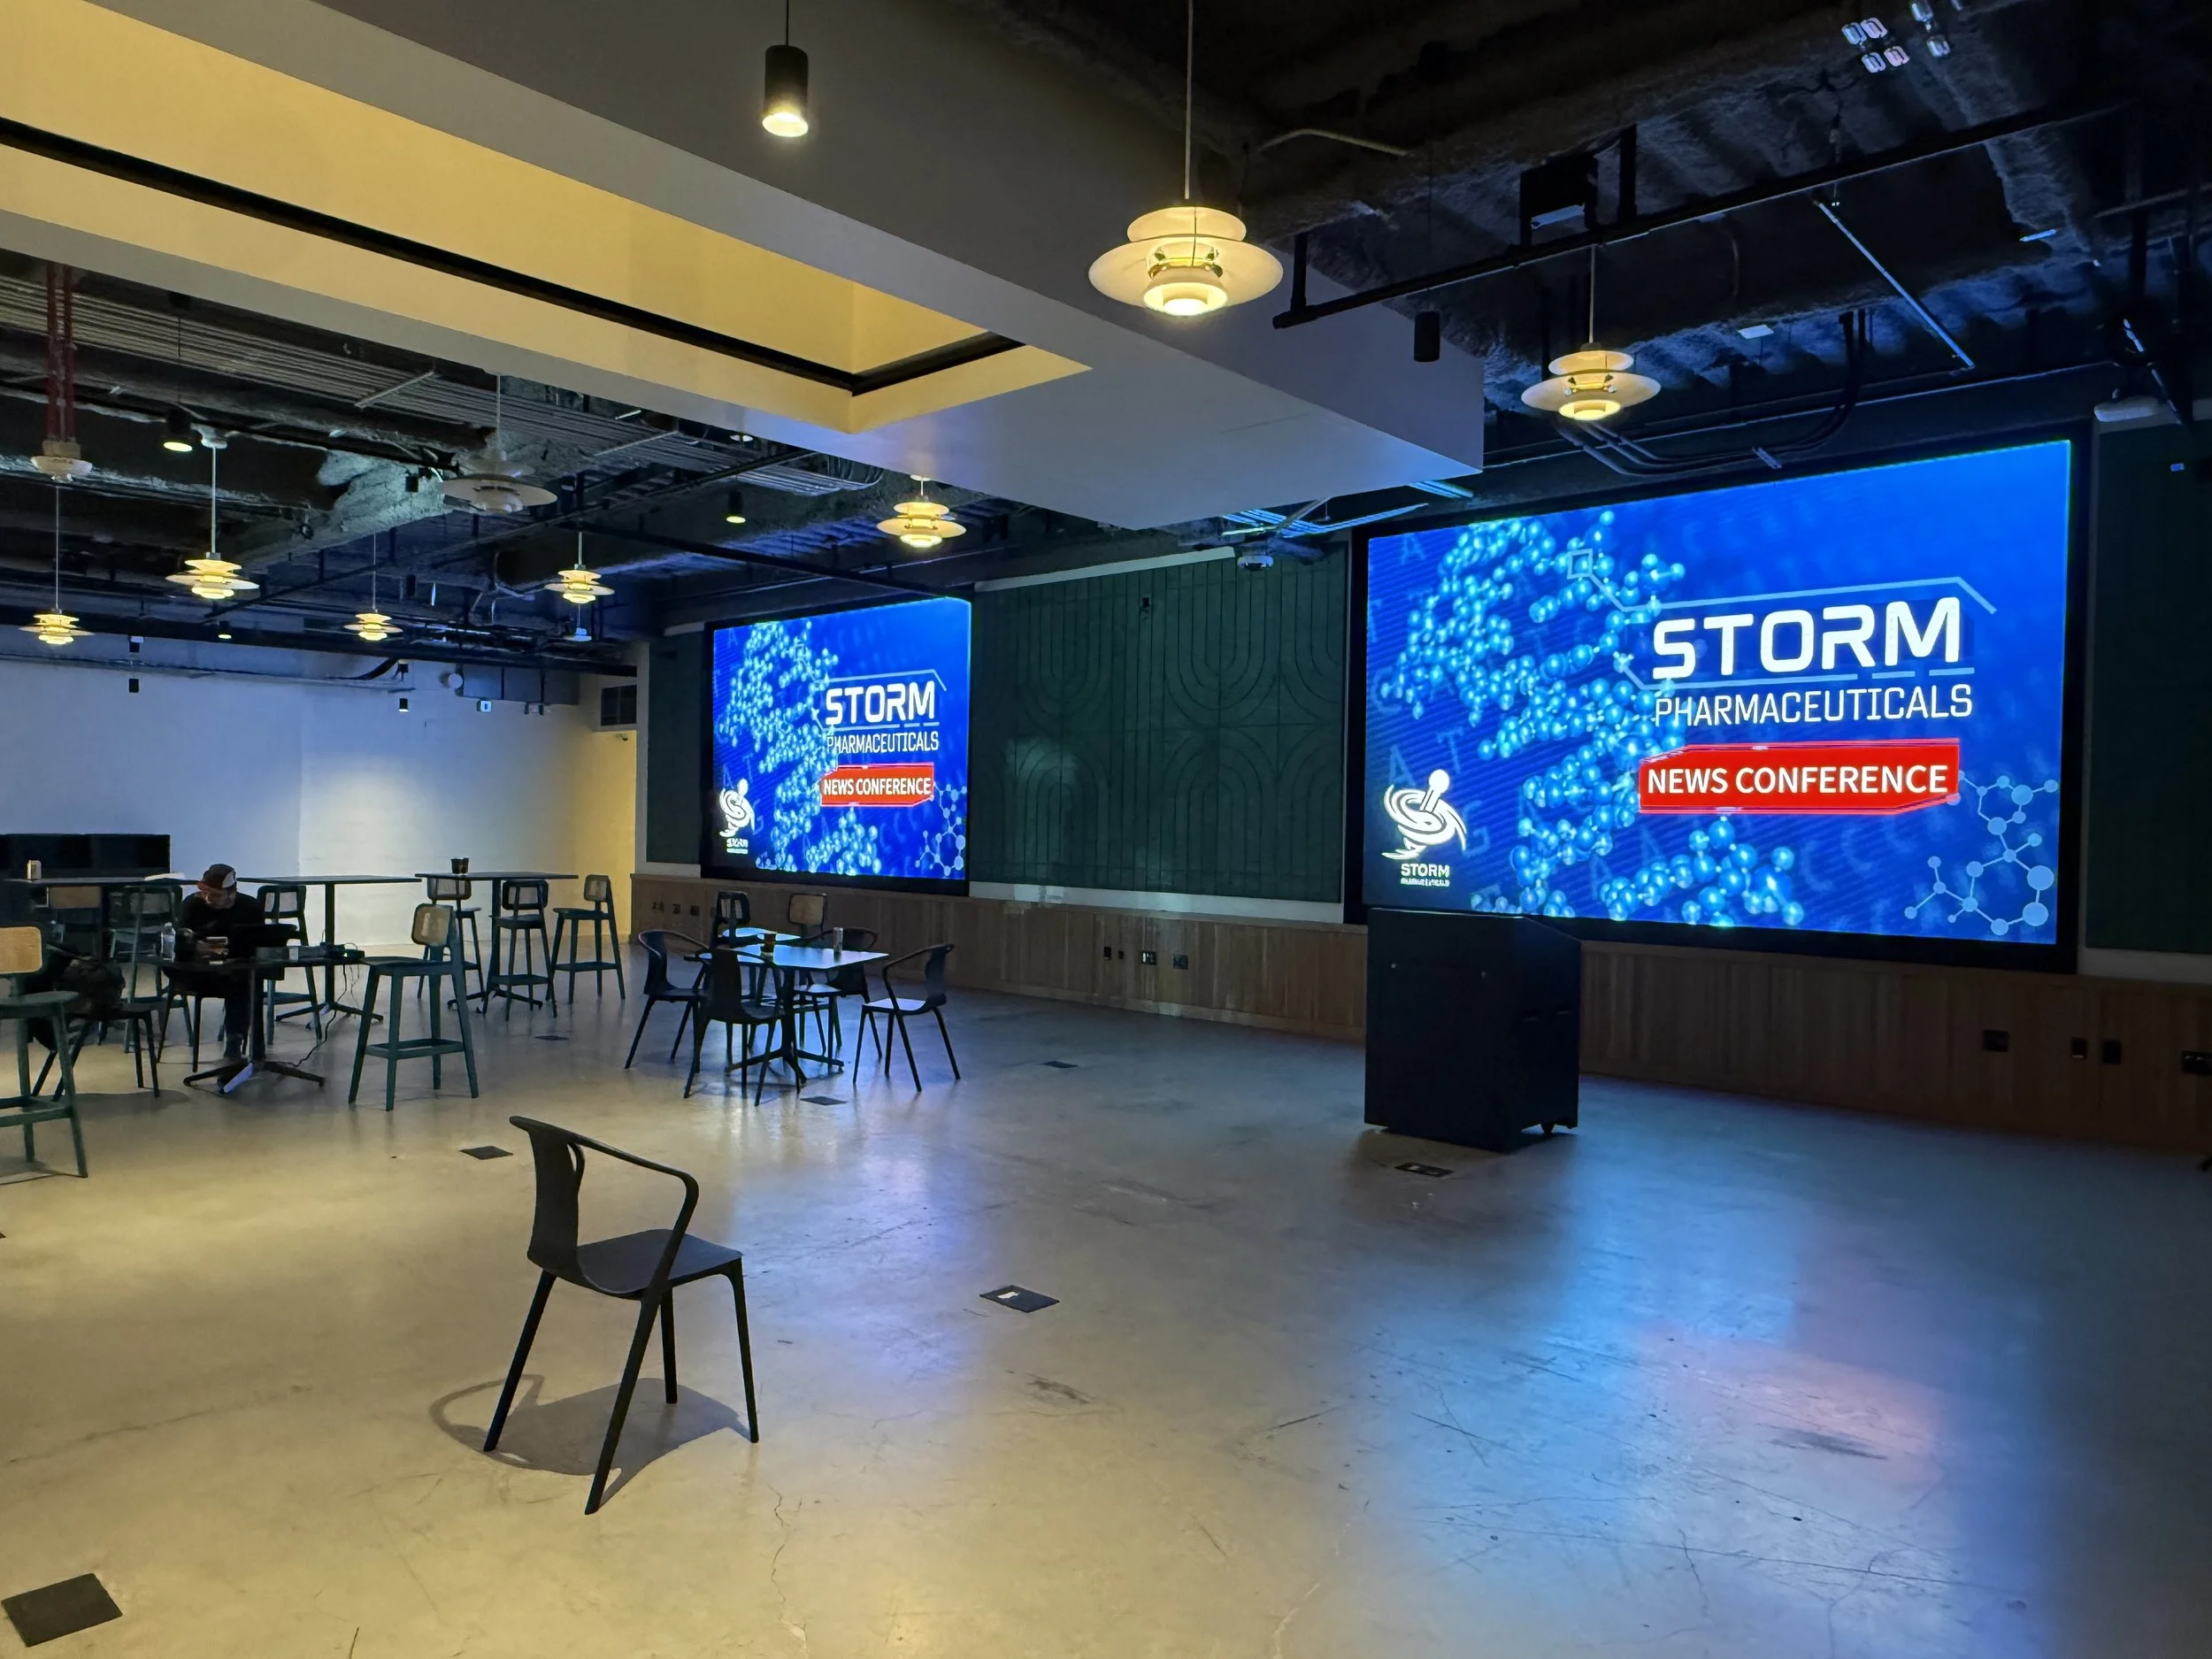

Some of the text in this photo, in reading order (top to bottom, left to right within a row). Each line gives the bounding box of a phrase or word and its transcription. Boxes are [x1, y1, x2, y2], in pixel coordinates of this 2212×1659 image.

[1652, 596, 1960, 680] STORM
[825, 680, 935, 726] STORM
[1655, 683, 1973, 727] PHARMACEUTICALS
[826, 731, 940, 754] PHARMACEUTICALS
[824, 777, 932, 795] NEWS CONFERENCE
[1647, 764, 1948, 794] NEWS CONFERENCE
[1401, 863, 1450, 878] STORM
